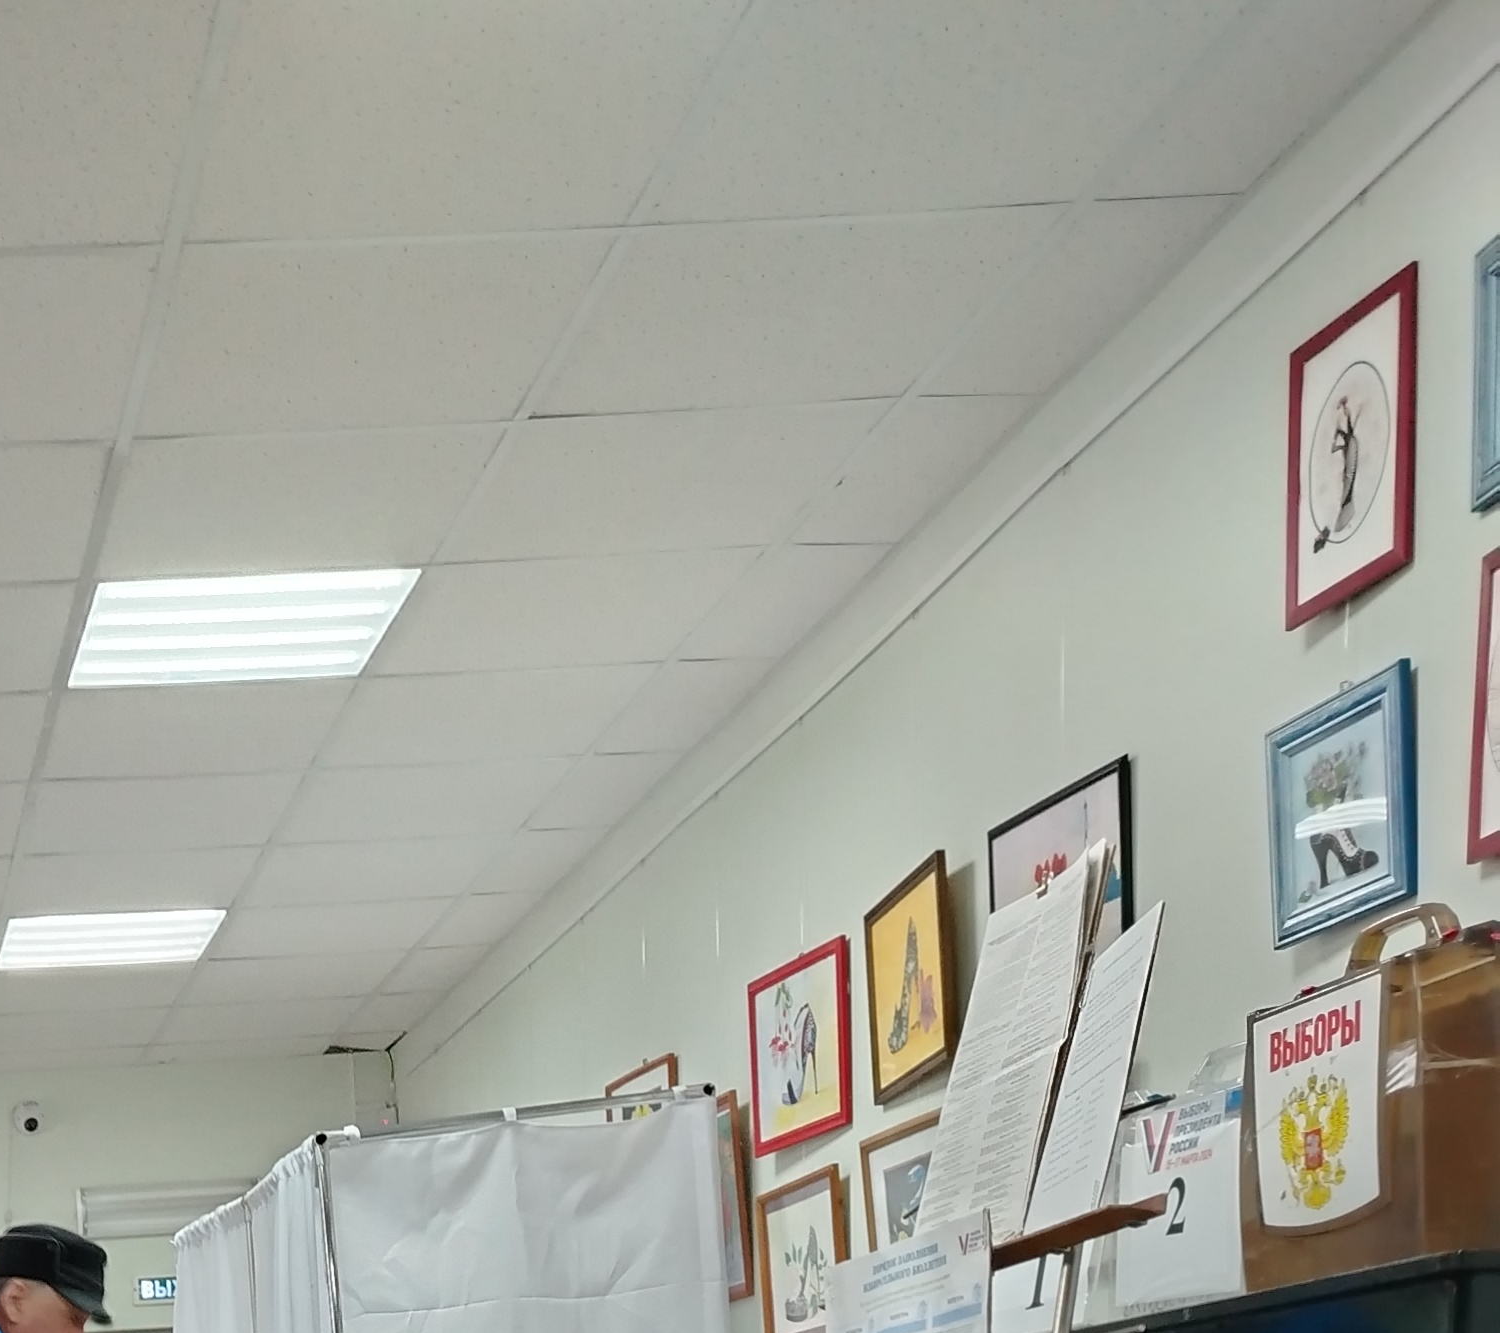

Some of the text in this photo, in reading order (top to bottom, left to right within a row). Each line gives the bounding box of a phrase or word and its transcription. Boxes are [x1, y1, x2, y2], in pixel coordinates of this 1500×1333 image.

[1269, 999, 1361, 1073] ВЫБОРЫ
[1177, 1100, 1212, 1120] ВЫБОРЫ
[1172, 1113, 1222, 1138] ПРЕЗИДЕНТА
[1168, 1136, 1200, 1156] РОССИИ
[1165, 1176, 1186, 1236] 2
